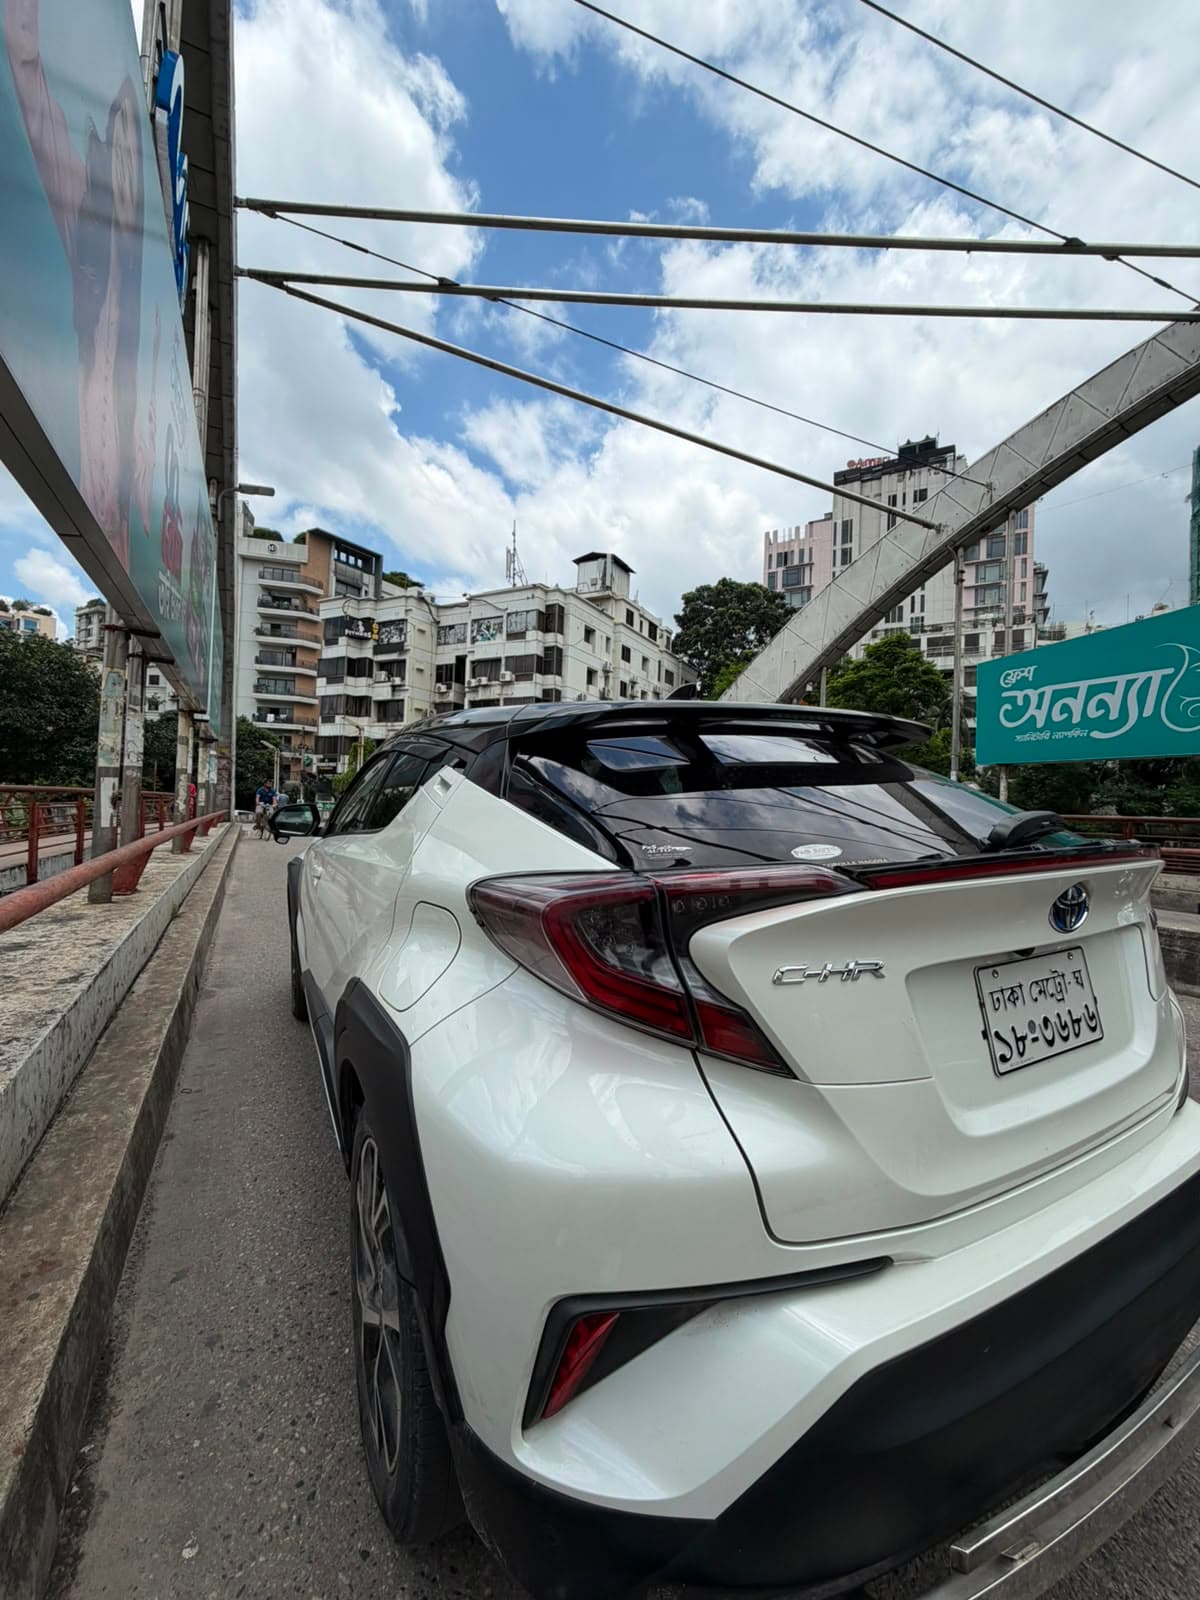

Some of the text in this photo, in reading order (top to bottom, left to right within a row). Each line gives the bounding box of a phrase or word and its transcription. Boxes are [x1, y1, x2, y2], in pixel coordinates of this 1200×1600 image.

[1000, 665, 1038, 688] ফ্রেশ
[999, 667, 1175, 739] অনন্যা
[989, 982, 1026, 1012] ঢাকা
[993, 1003, 1099, 1064] ১৮-৩৬৮৬
